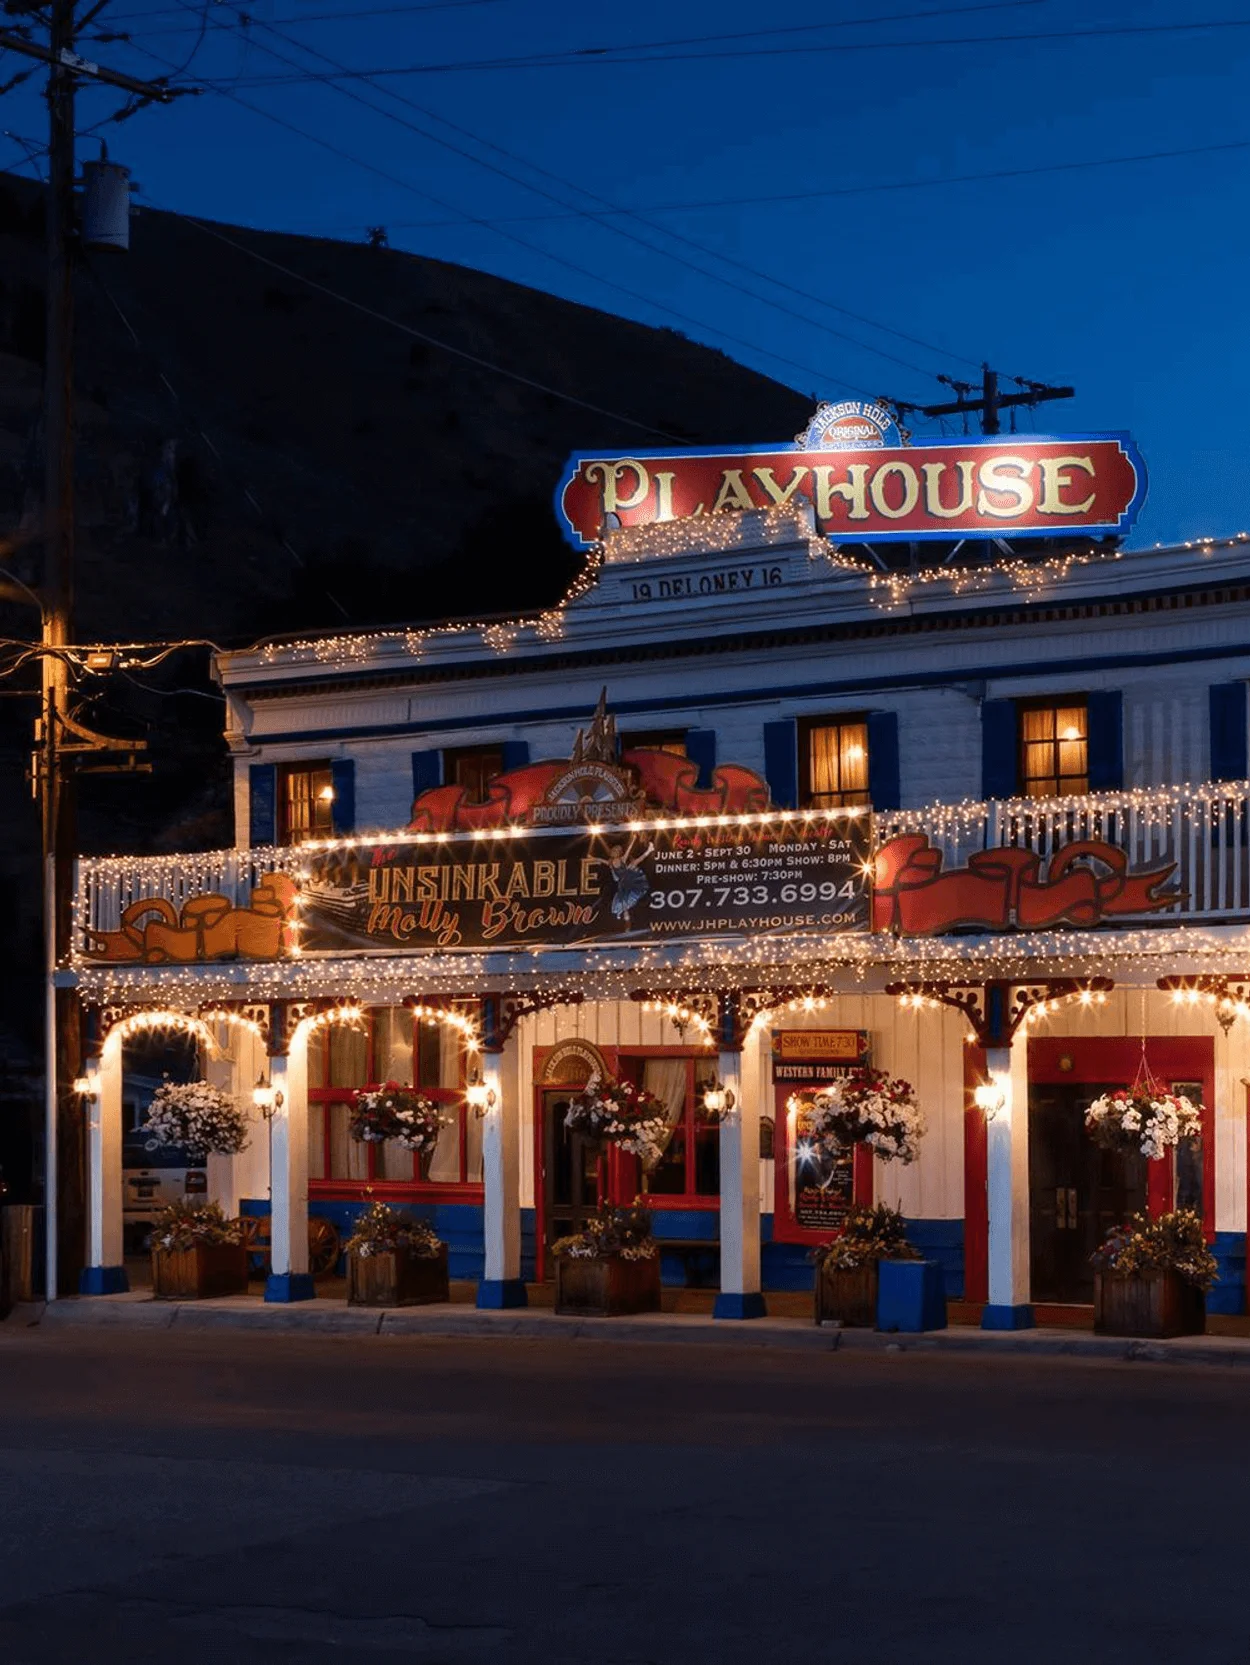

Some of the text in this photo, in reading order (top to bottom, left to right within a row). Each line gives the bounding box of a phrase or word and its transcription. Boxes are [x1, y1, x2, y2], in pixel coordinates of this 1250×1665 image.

[815, 402, 890, 434] JACKSON HOLE
[828, 425, 878, 439] ORIGINAL
[585, 456, 1097, 522] PLAYHOUSE
[632, 566, 783, 599] 19 DELONEY 16
[533, 801, 639, 822] PROUDLY PRESENTS
[654, 850, 683, 861] JUNE
[686, 848, 694, 859] 2
[736, 846, 751, 856] 30
[769, 841, 816, 854] MONDAY
[829, 839, 852, 849] SAT
[703, 861, 726, 871] 5PM
[729, 859, 738, 869] &
[742, 857, 782, 868] 6:30PM
[827, 853, 850, 864] 8PM
[368, 858, 601, 904] UNSINKABLE
[762, 870, 802, 880] 7:30PM
[649, 880, 855, 909] 307.733.6994
[367, 896, 600, 946] Molly Brown
[650, 912, 856, 932] WWW.JHPLAYHOUSE.COM
[783, 1036, 810, 1048] SHOW
[776, 1066, 814, 1078] WESTERN
[816, 1066, 846, 1078] FAMILY
